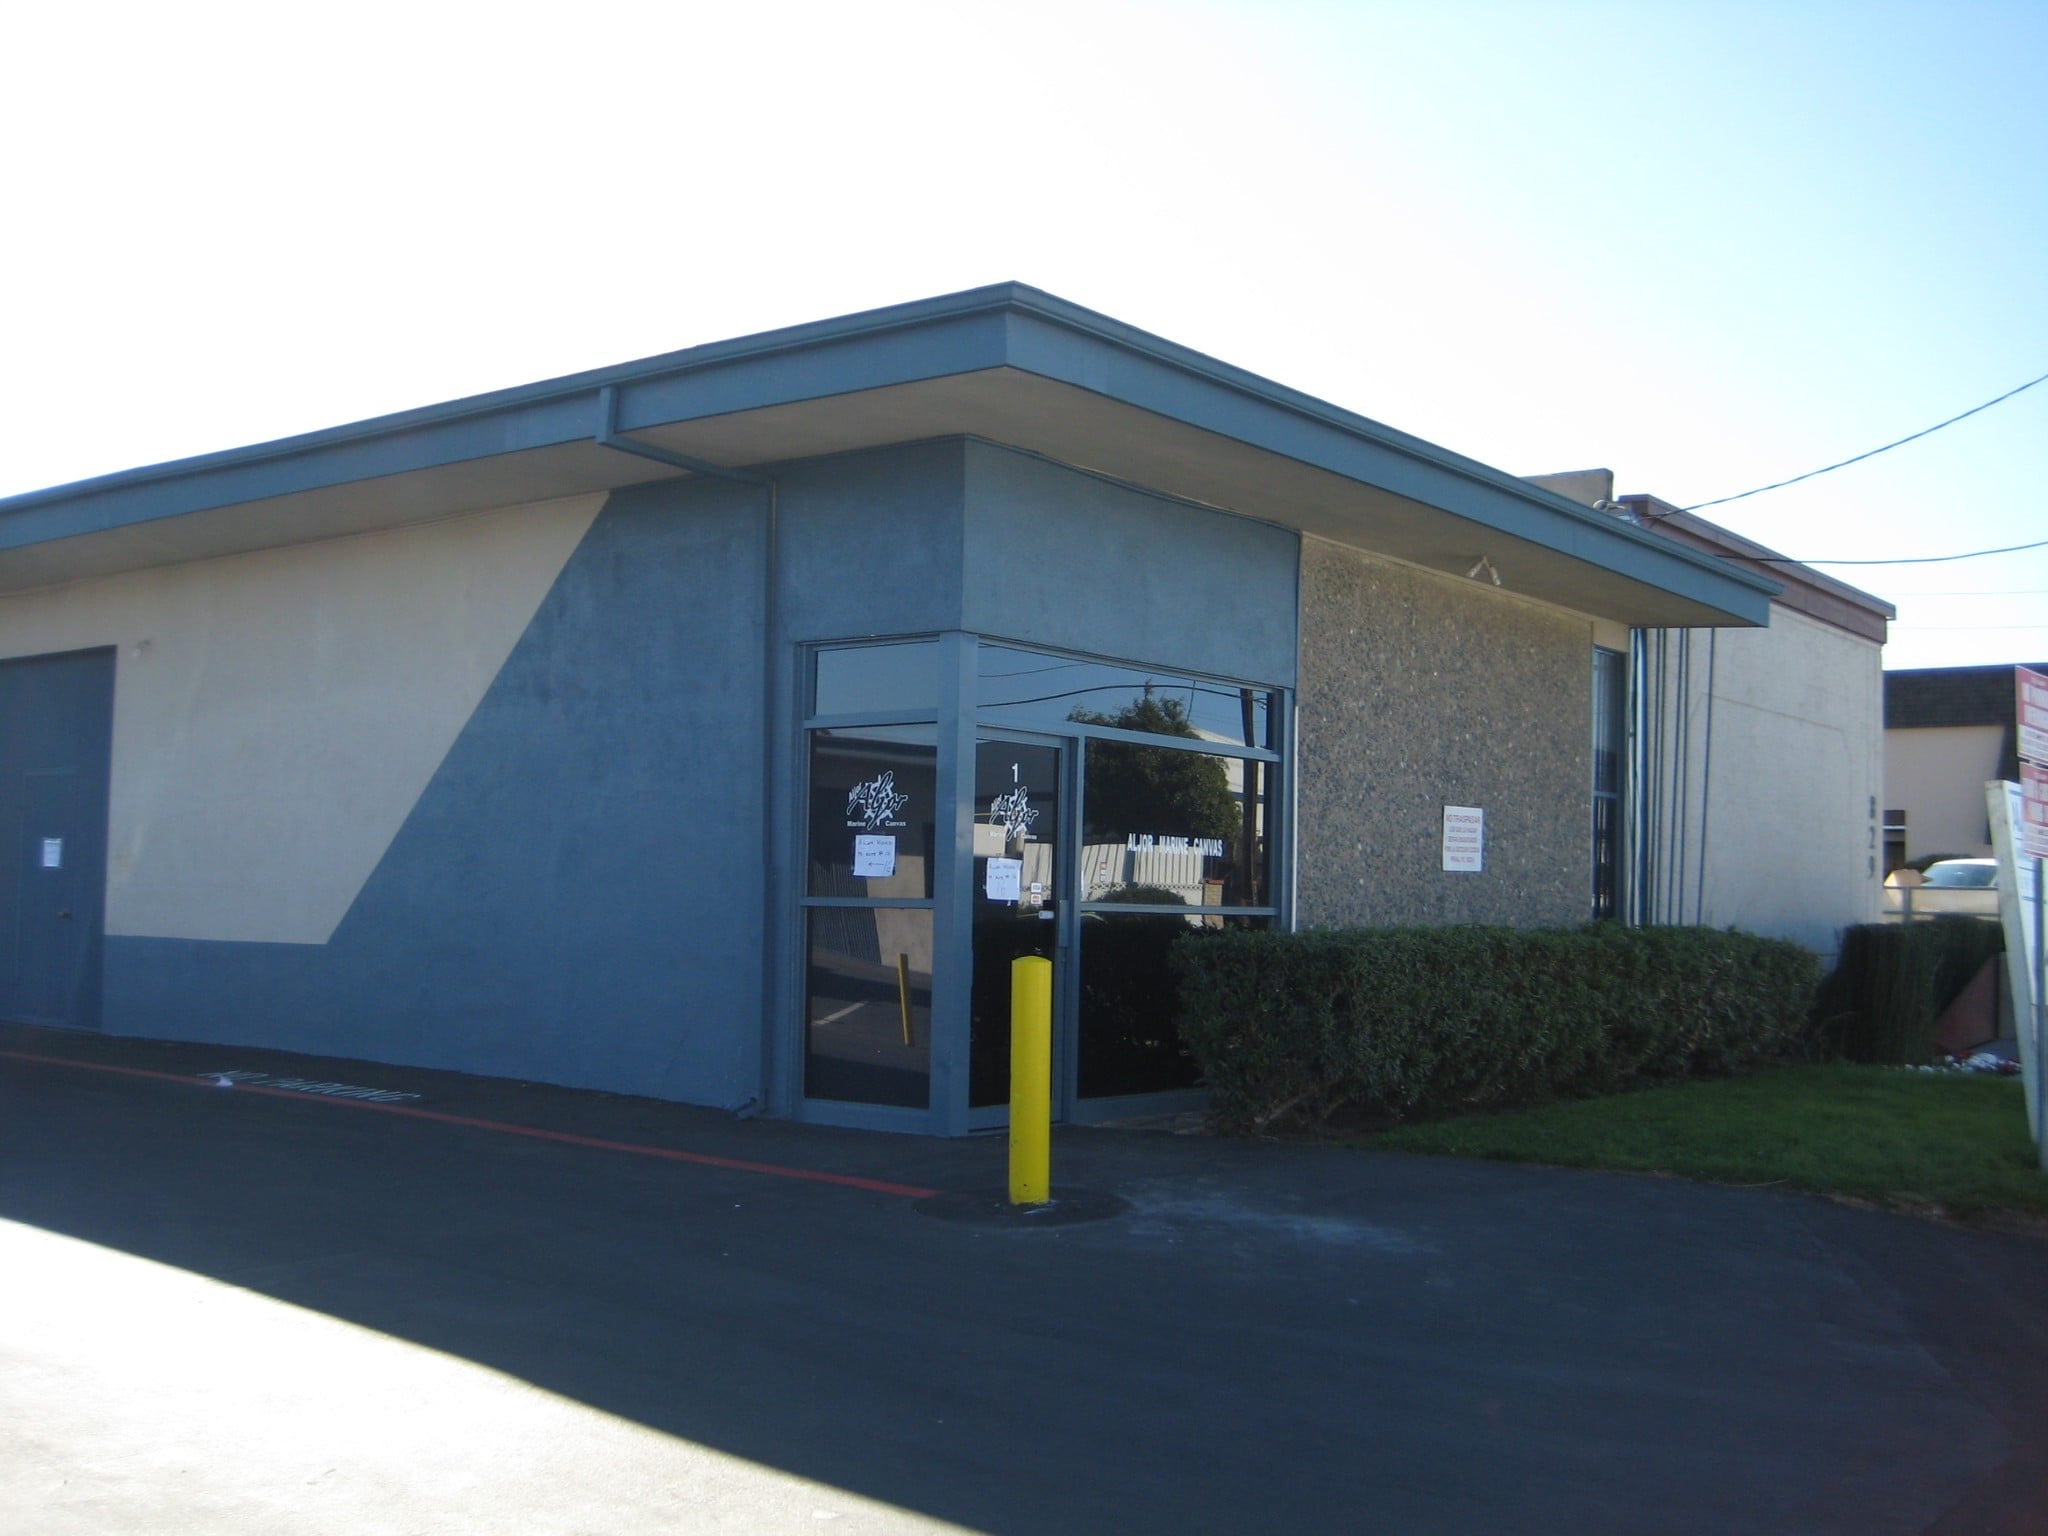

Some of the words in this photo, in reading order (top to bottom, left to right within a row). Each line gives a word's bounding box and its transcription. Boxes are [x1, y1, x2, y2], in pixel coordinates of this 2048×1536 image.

[1012, 763, 1018, 783] 1
[1127, 833, 1153, 852] ALJOR
[1159, 835, 1189, 855] MARINE
[1193, 837, 1223, 857] CANVAS
